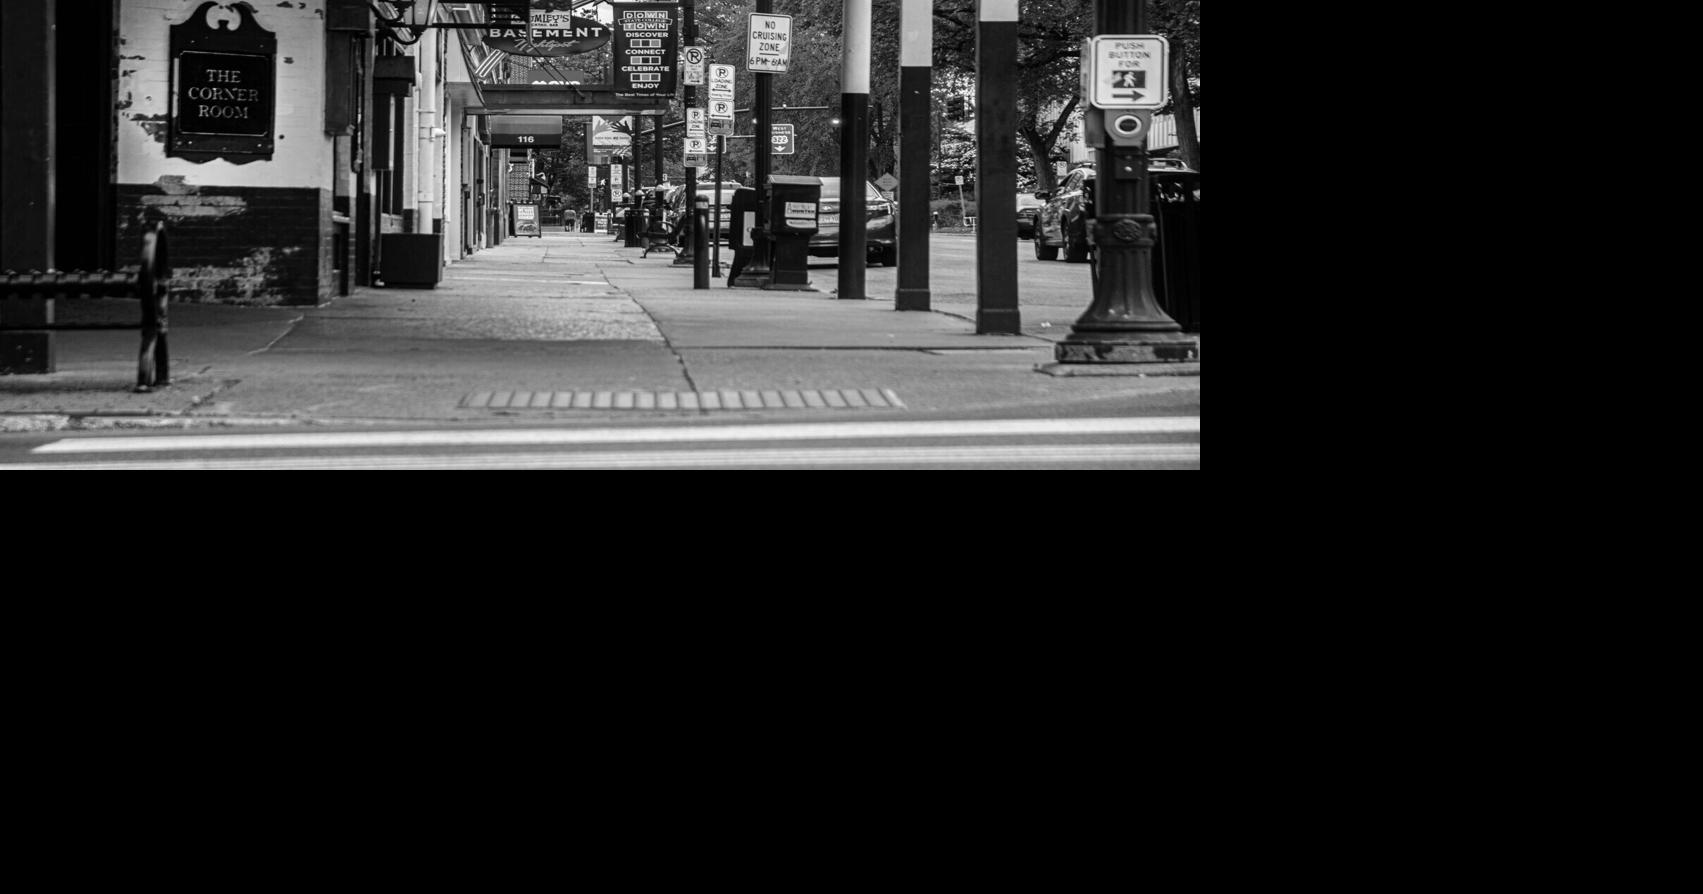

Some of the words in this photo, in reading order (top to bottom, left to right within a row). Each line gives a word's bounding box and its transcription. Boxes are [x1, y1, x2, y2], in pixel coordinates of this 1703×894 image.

[765, 21, 776, 30] NO
[490, 28, 602, 38] BASEMENT
[752, 31, 787, 42] CRUISING
[760, 42, 780, 52] ZONE
[1108, 51, 1151, 59] BUTTON
[206, 69, 241, 83] THE
[188, 86, 259, 102] CORNER
[198, 104, 248, 119] ROOM
